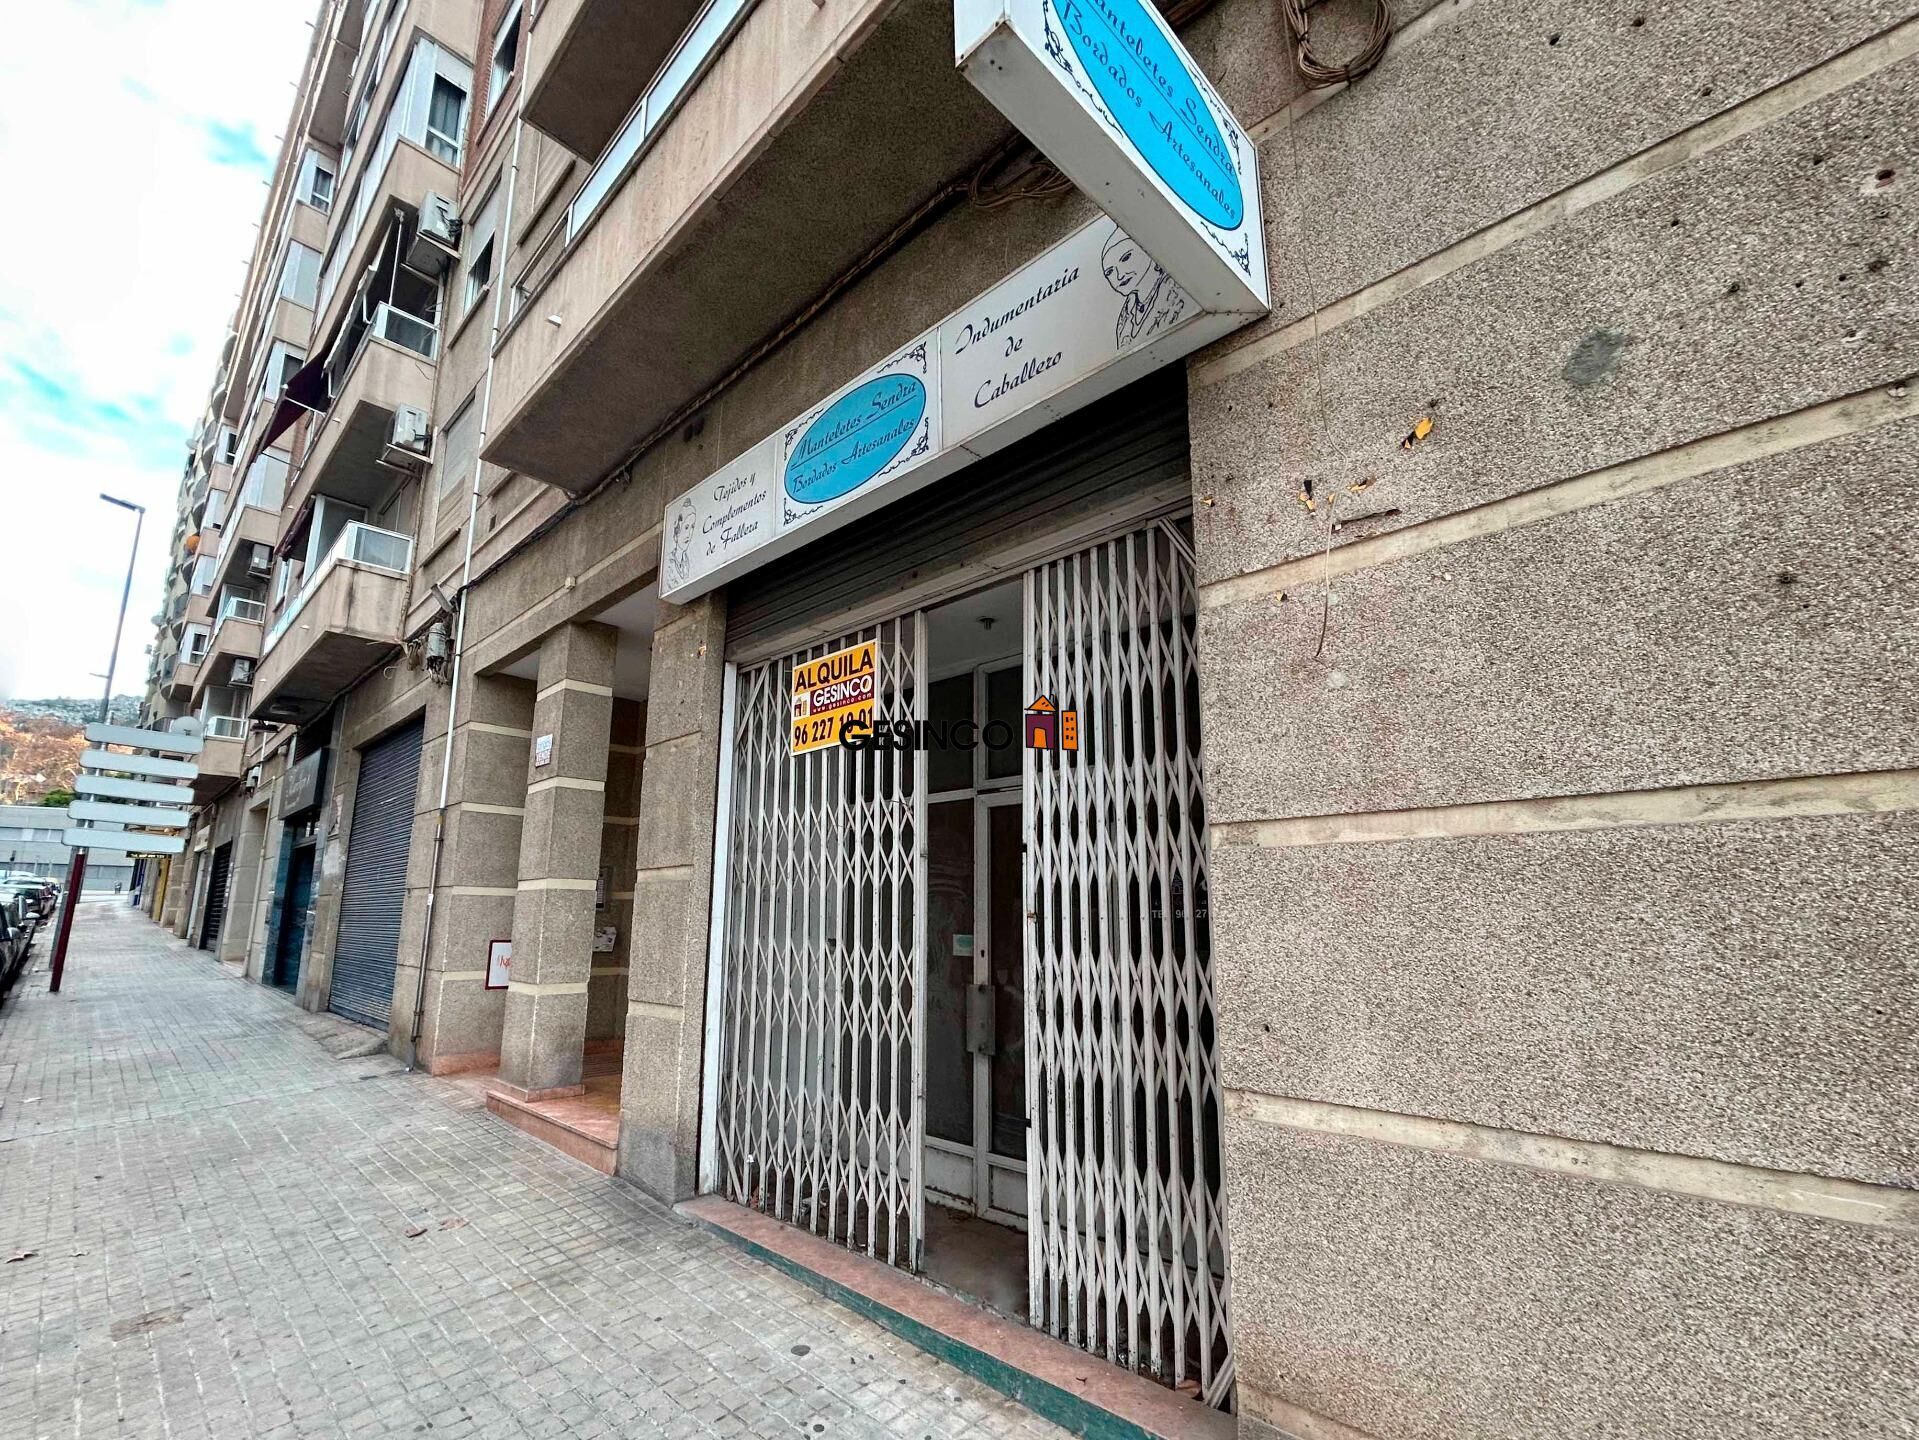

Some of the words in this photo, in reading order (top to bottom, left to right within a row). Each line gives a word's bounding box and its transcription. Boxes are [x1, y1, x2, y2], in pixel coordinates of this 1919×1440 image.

[1063, 0, 1142, 108] Bordados
[1149, 110, 1236, 221] Artesanales
[1092, 0, 1174, 98] anteletes
[1179, 97, 1236, 177] Sendra
[955, 266, 1080, 355] Indumentaria
[1005, 336, 1023, 358] de
[974, 351, 1063, 409] Caballero
[800, 408, 863, 460] Manteletes
[866, 381, 917, 419] Sendra
[791, 461, 838, 495] Bordados
[841, 416, 916, 466] Artesanales
[713, 477, 748, 506] Tejidos
[748, 471, 757, 486] y
[702, 489, 768, 535] Complementos
[706, 542, 717, 558] de
[720, 519, 759, 549] Fallera
[794, 648, 874, 693] ALQUILA
[813, 674, 873, 707] GESINCO
[812, 692, 873, 713] www.gesinco.com
[794, 723, 809, 747] 96
[811, 716, 835, 743] 227
